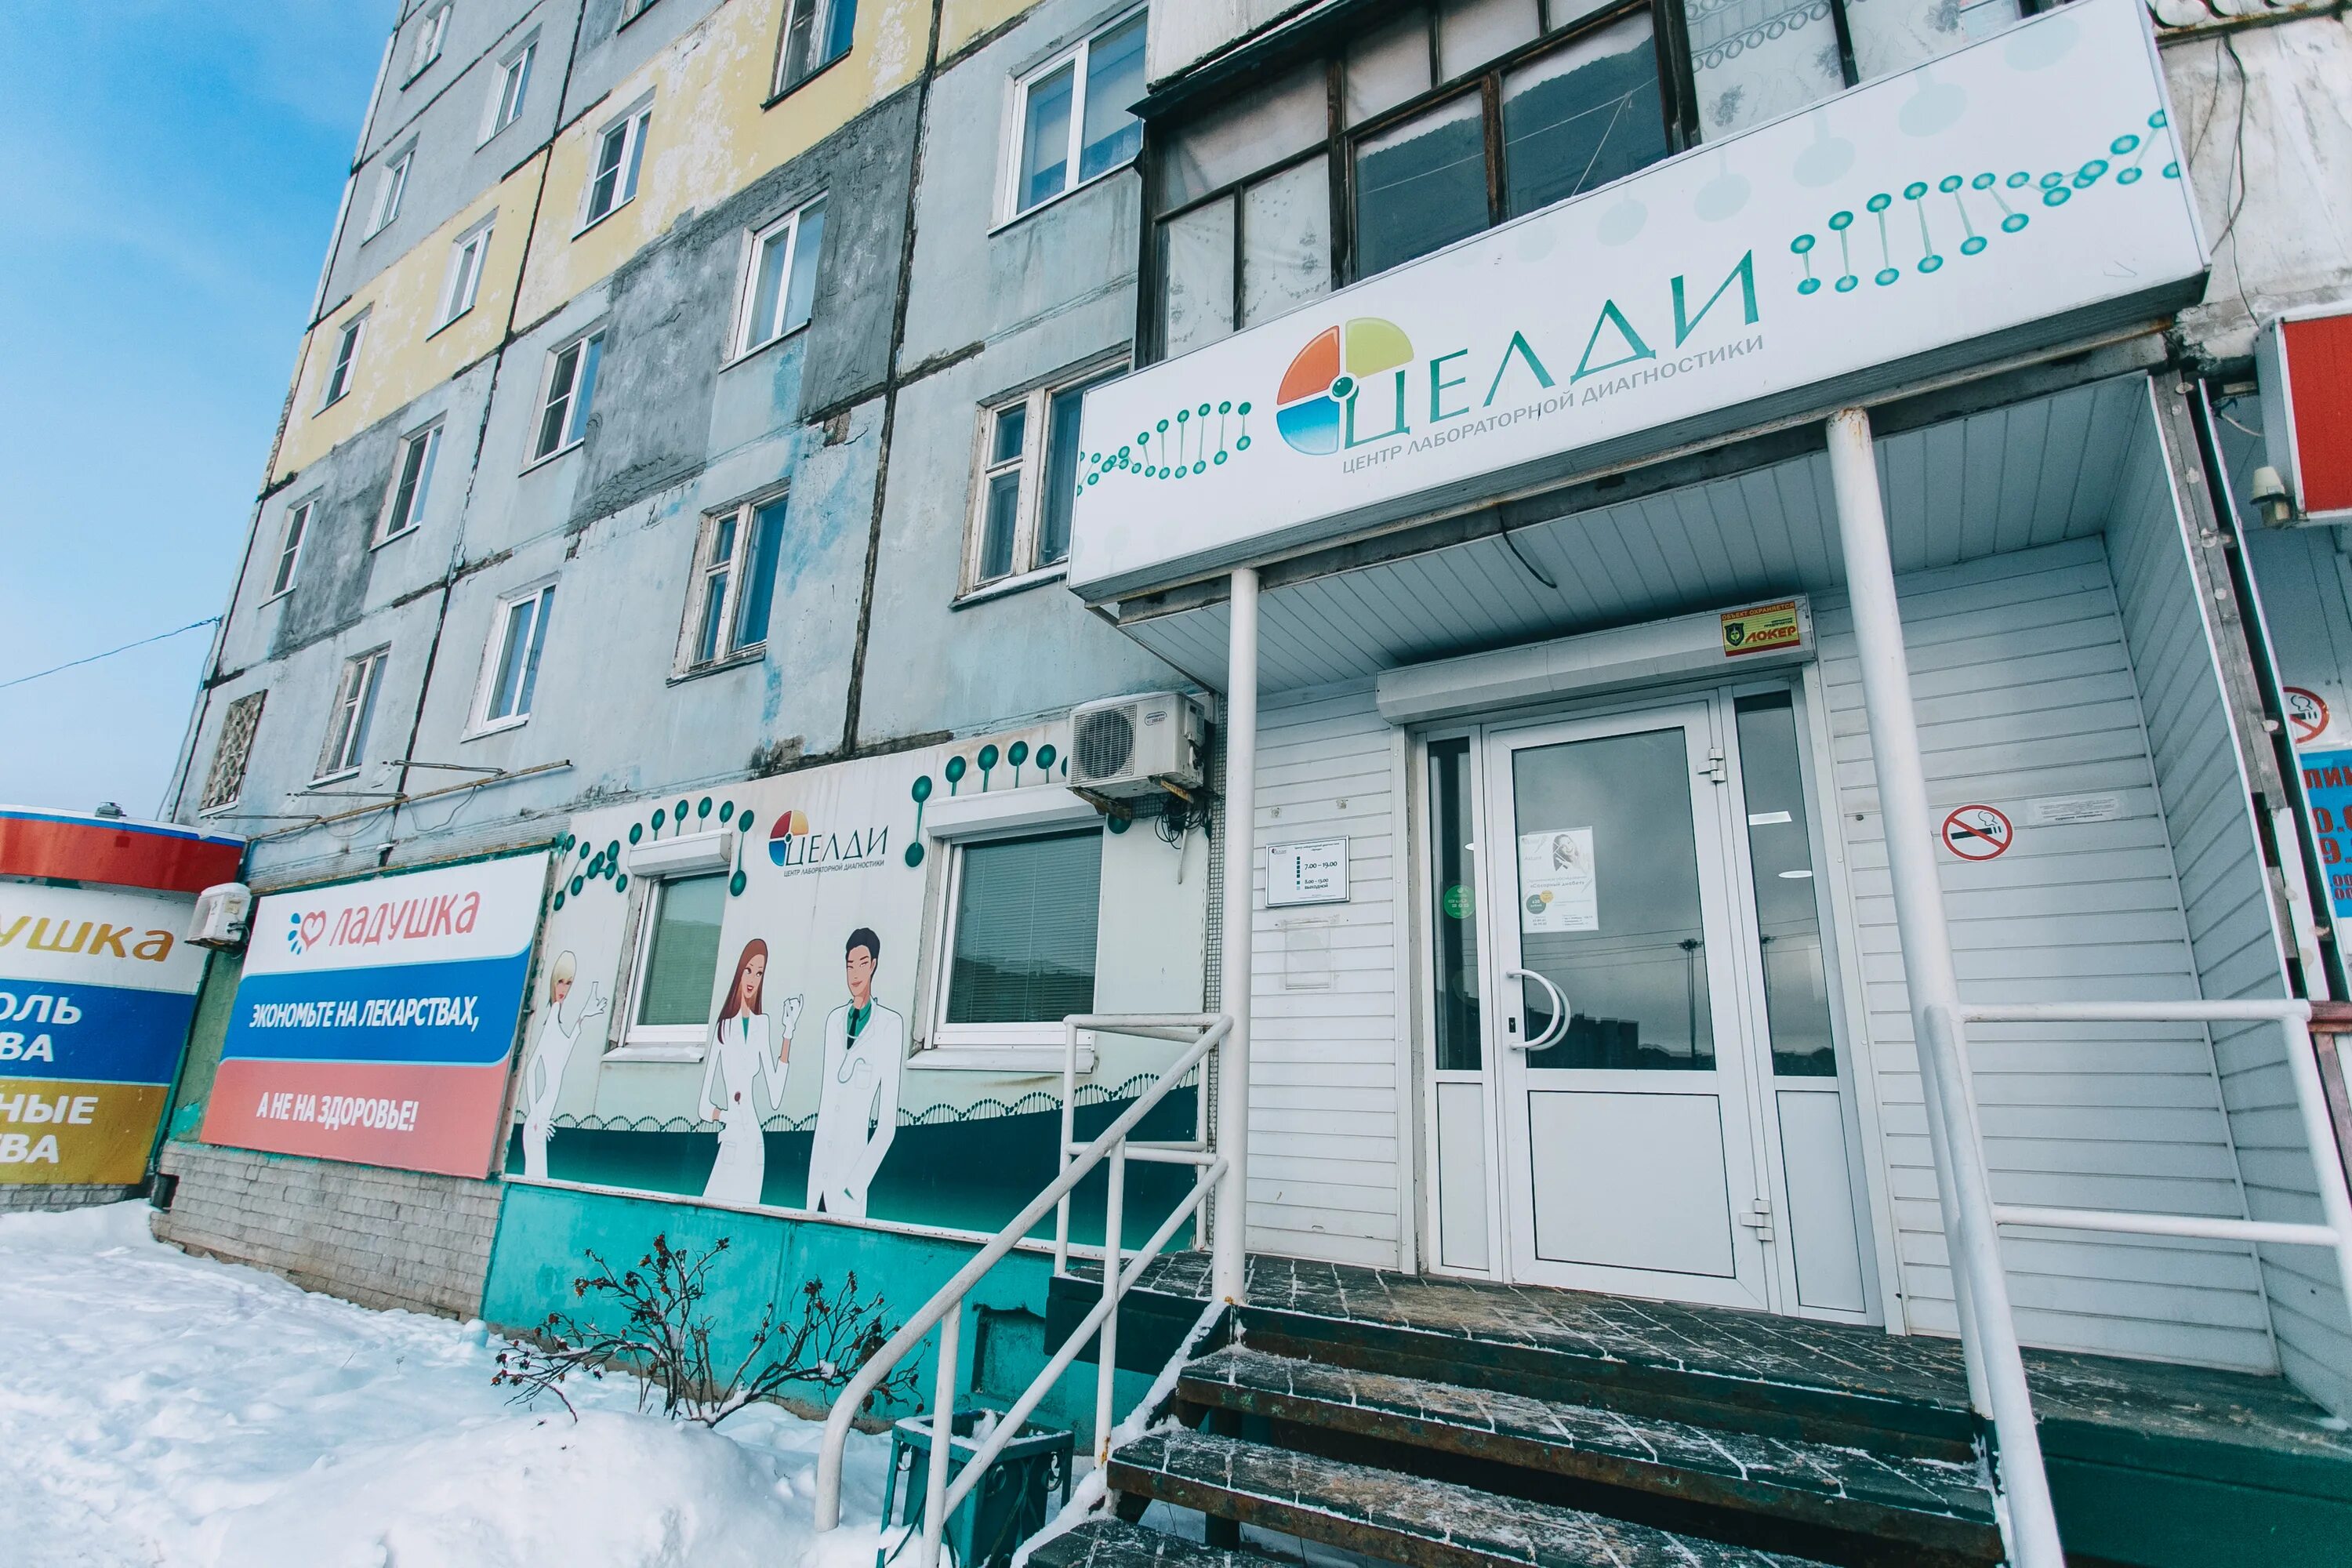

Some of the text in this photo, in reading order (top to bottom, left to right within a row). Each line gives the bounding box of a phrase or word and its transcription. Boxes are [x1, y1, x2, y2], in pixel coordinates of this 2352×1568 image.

[1335, 249, 1760, 449] ЦЕЛДИ
[1342, 335, 1763, 474] ЦЕНТР ЛАБОРАТОРНОЙ ДИАГНОСТИКИ
[1722, 603, 1795, 620] ОБЪЕКТ ОХРАНЯЕТСЯ
[1745, 626, 1797, 644] ЛОКЕР
[785, 825, 889, 866] ЦЕЛДИ
[784, 859, 884, 877] ЦЕНТР ЛАБОРАТОРНОЙ ДИАГНОСТИКИ
[249, 996, 479, 1033] ЭКОНОМЬТЕ НА ЛЕКАРСТВАХ,
[256, 1092, 419, 1131] А НЕ НА ЗДОРОВЬЕ!
